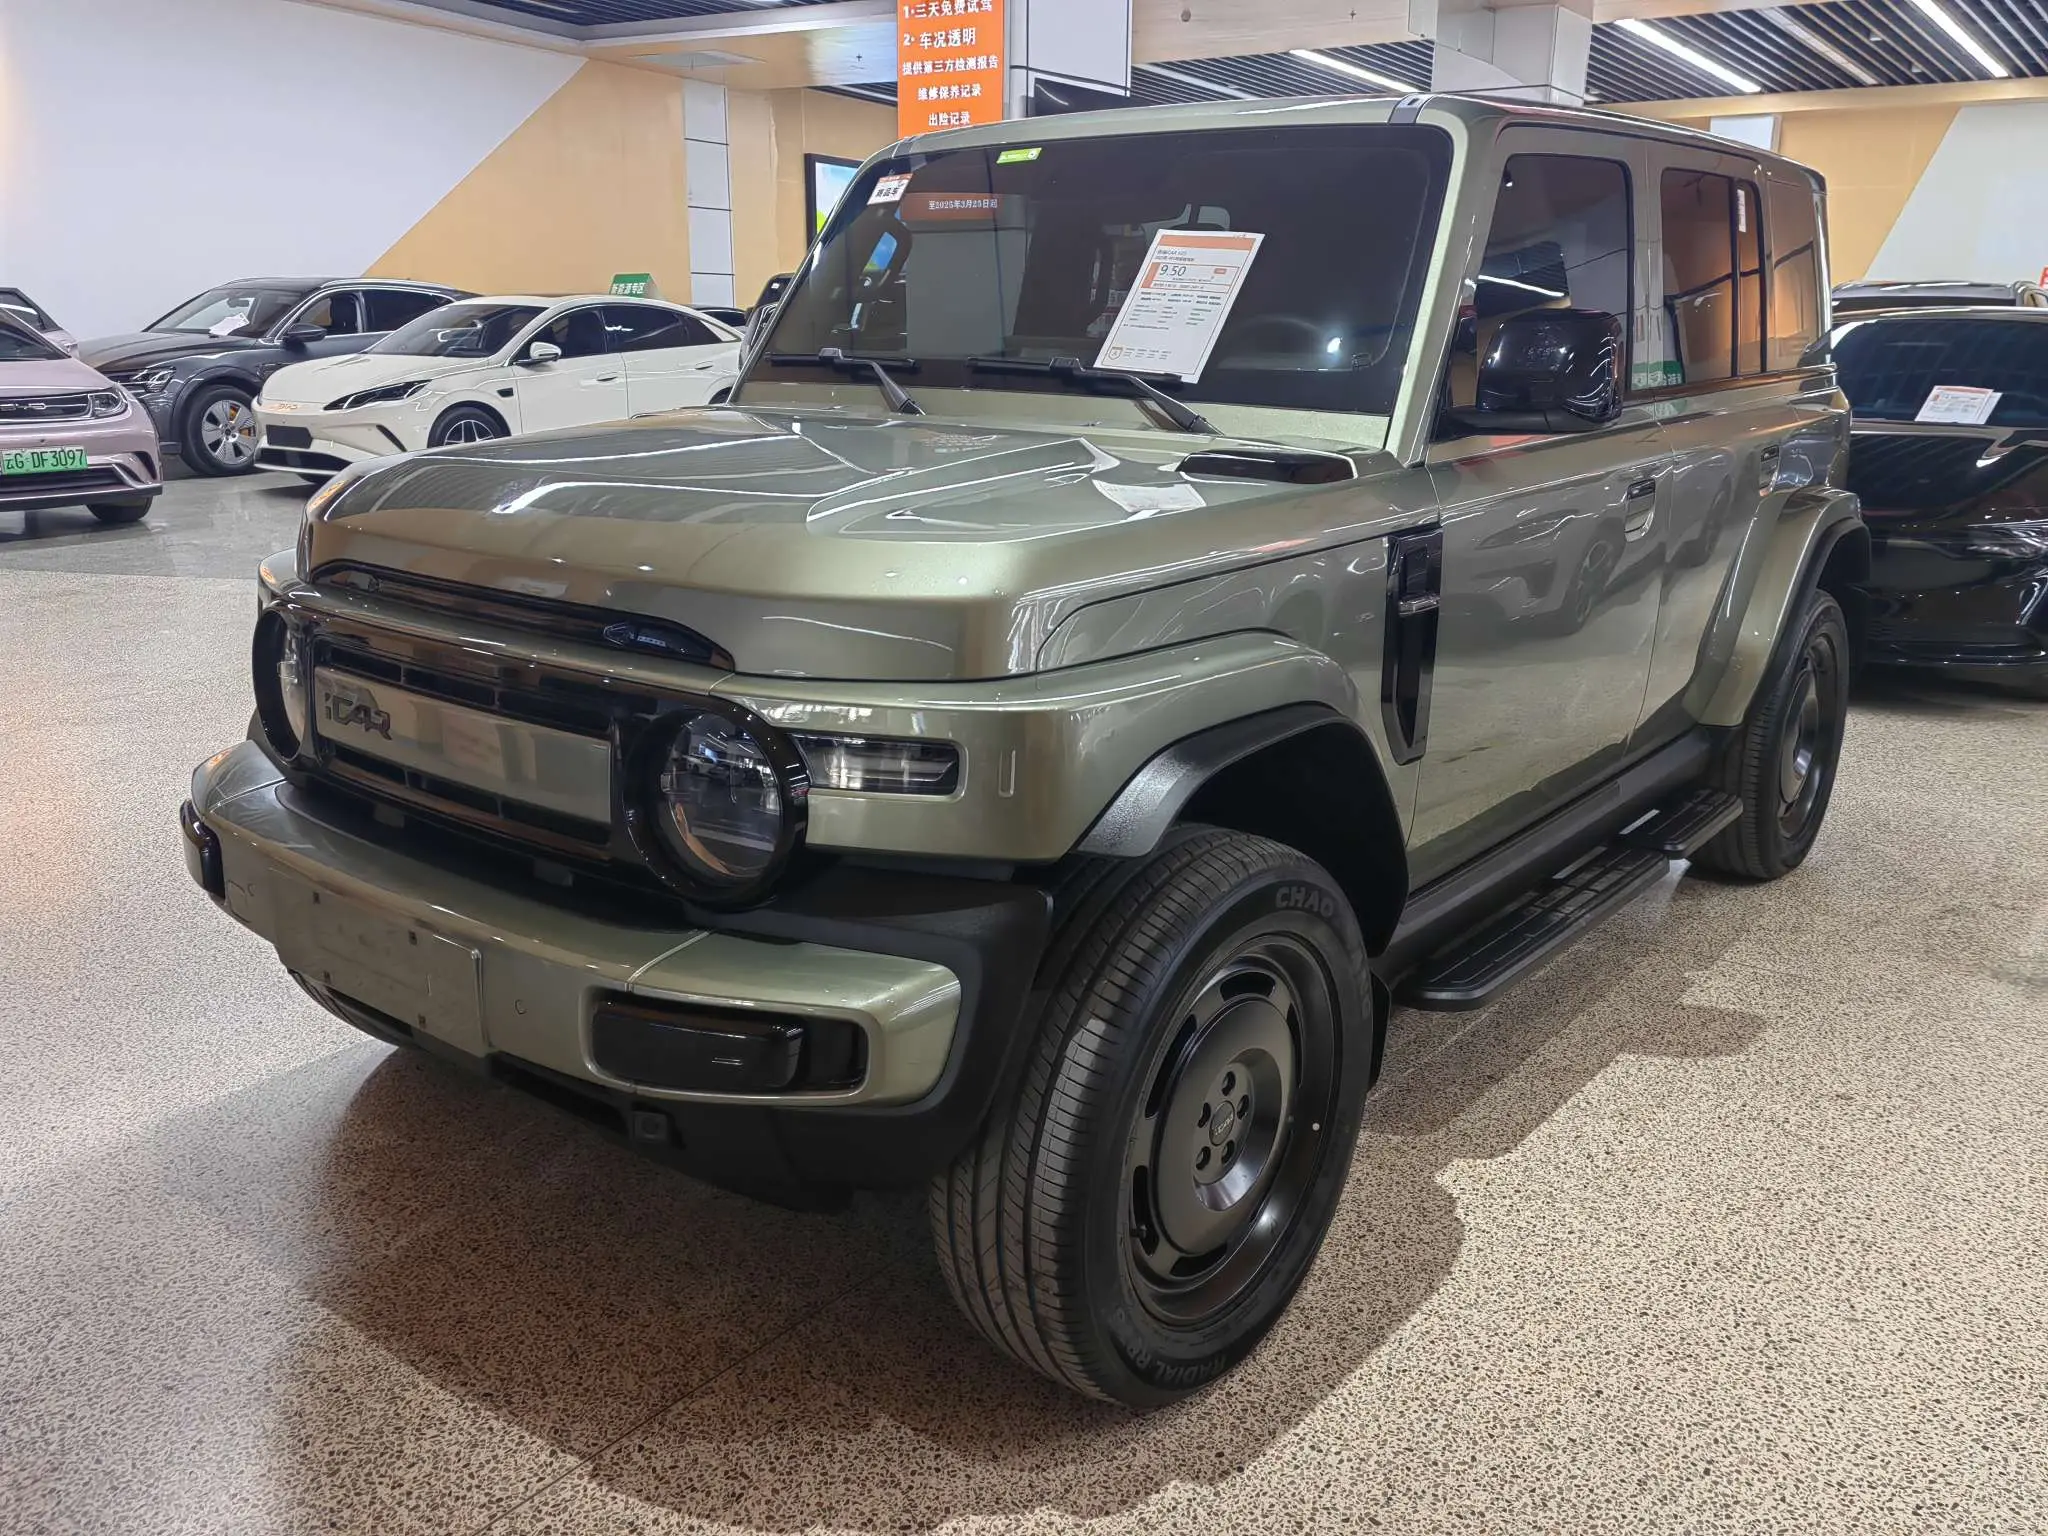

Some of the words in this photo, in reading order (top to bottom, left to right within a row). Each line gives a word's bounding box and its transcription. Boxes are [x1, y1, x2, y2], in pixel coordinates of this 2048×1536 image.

[919, 27, 976, 50] 车况透明
[902, 54, 999, 76] 提供第三方检测报告
[918, 83, 982, 101] 维修保养记录
[928, 111, 971, 126] 出险记录
[1159, 264, 1187, 277] 9.50
